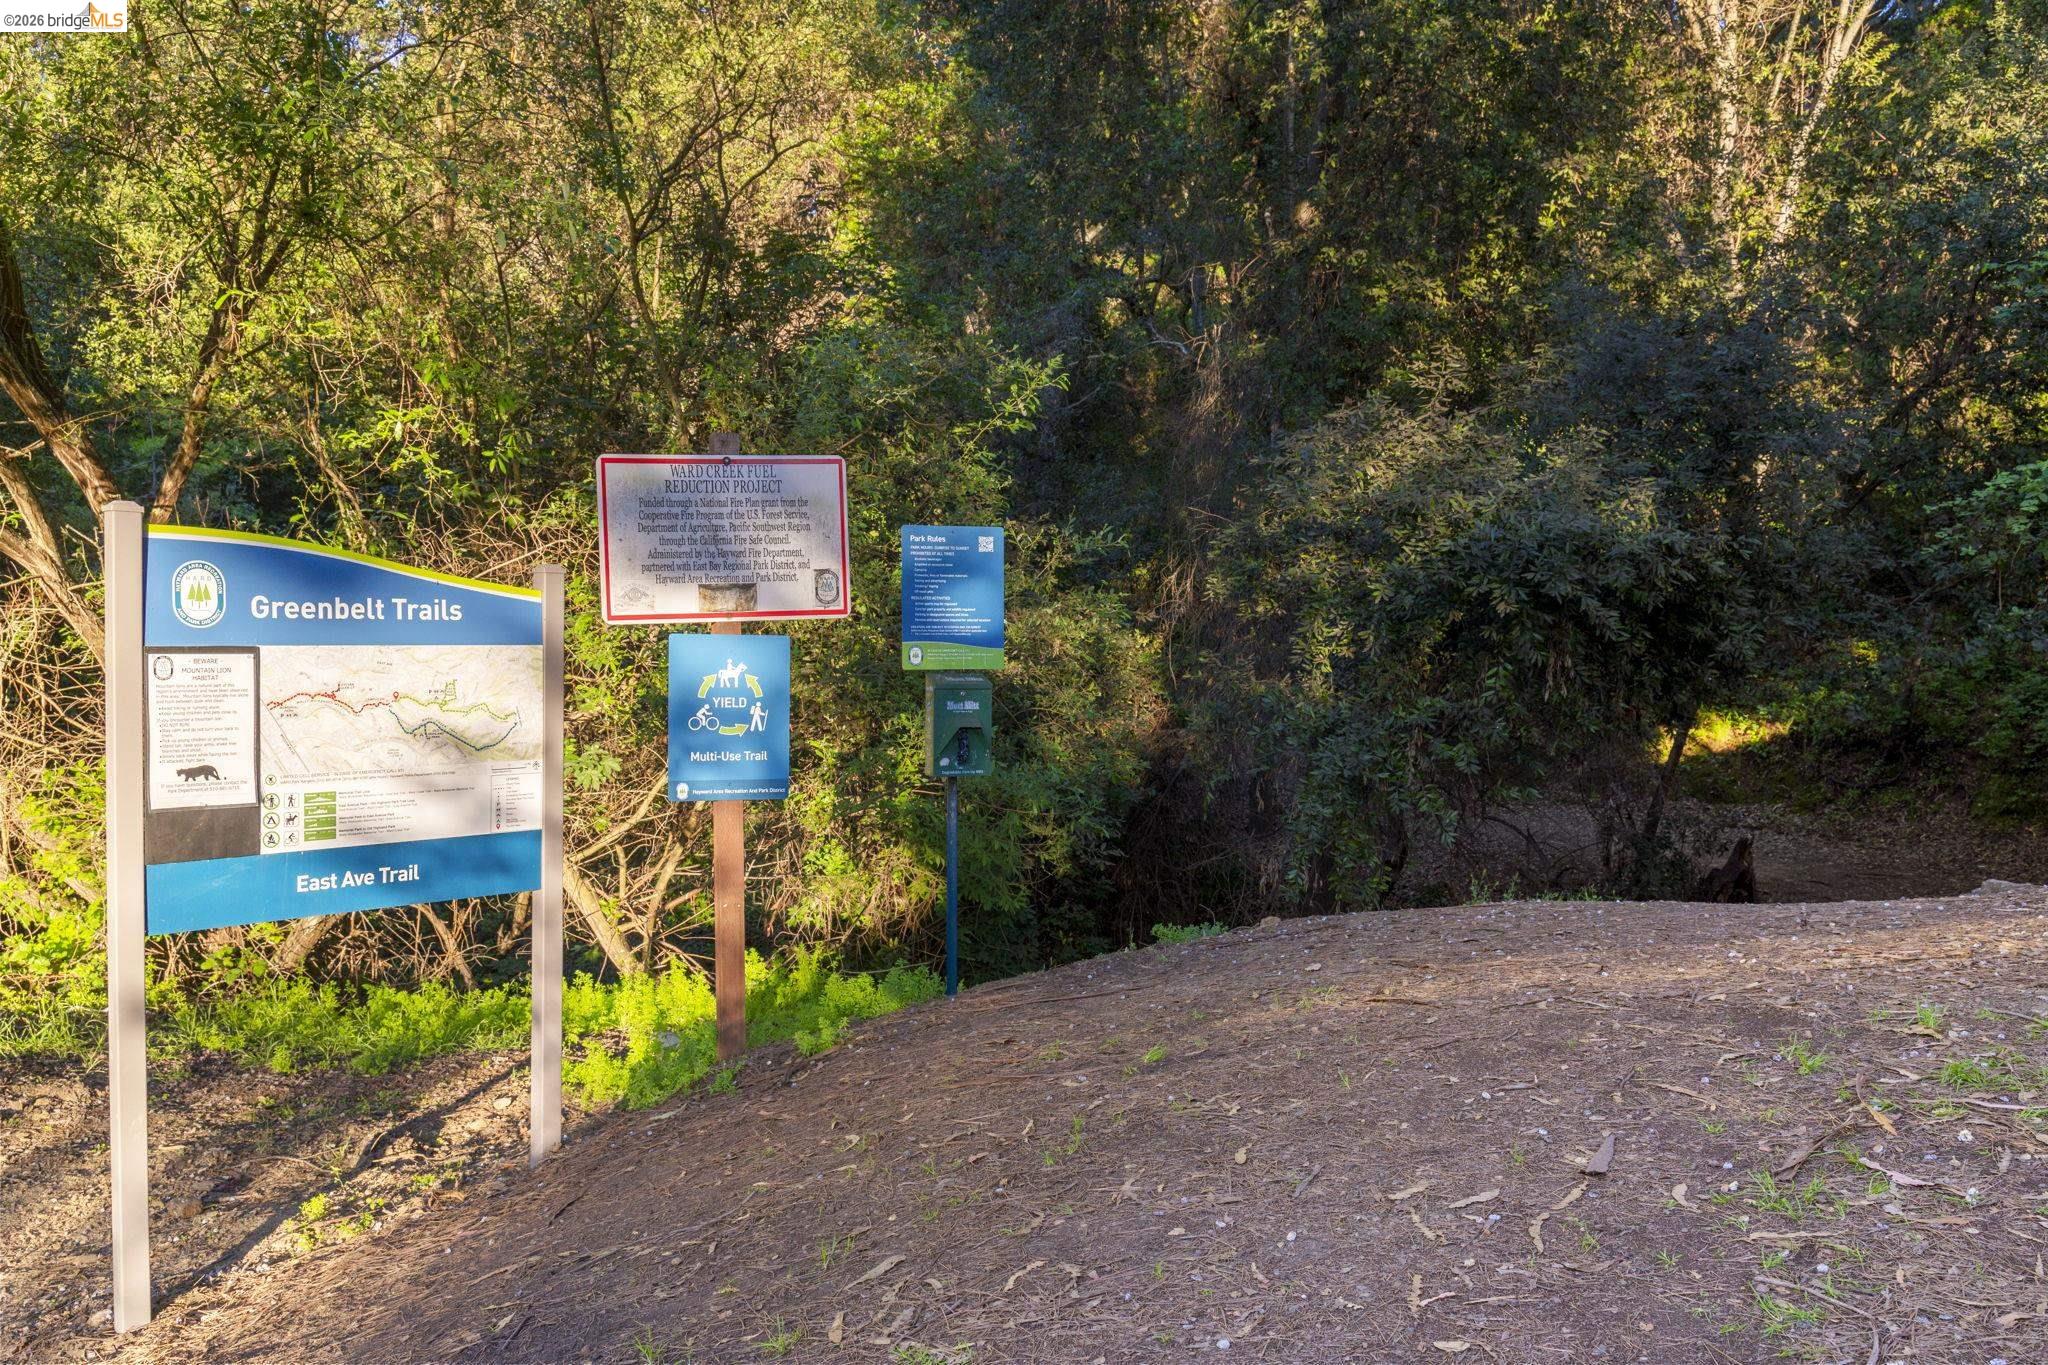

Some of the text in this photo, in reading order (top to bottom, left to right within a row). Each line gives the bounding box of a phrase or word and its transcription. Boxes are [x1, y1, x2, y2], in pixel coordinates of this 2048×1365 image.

[670, 464, 776, 478] WARD CREEK FUEL
[665, 480, 782, 493] REDUCTION PROJECT
[639, 497, 664, 507] Funded
[666, 497, 692, 510] through
[700, 497, 728, 507] National
[730, 497, 743, 507] Fire
[745, 497, 760, 507] Plan
[761, 499, 779, 509] grant
[781, 497, 796, 507] from
[798, 497, 808, 506] the
[639, 509, 809, 522] Cooperative Fire Program of the U.S. Forest Service,
[638, 522, 810, 535] Department of Agriculture, Pacific Southwest Region
[659, 534, 791, 548] through the California Fire Safe Council.
[648, 548, 804, 560] Administered by the Hayward Fire Department,
[642, 559, 810, 574] partnered with East Bay Regional Park District, and
[656, 572, 798, 586] Hayward Area Recreation and Park District.
[250, 595, 463, 621] Greenbelt Trails
[712, 697, 747, 708] YIELD
[690, 751, 767, 762] Multi-Use Trail
[296, 864, 420, 892] East Ave Trail
